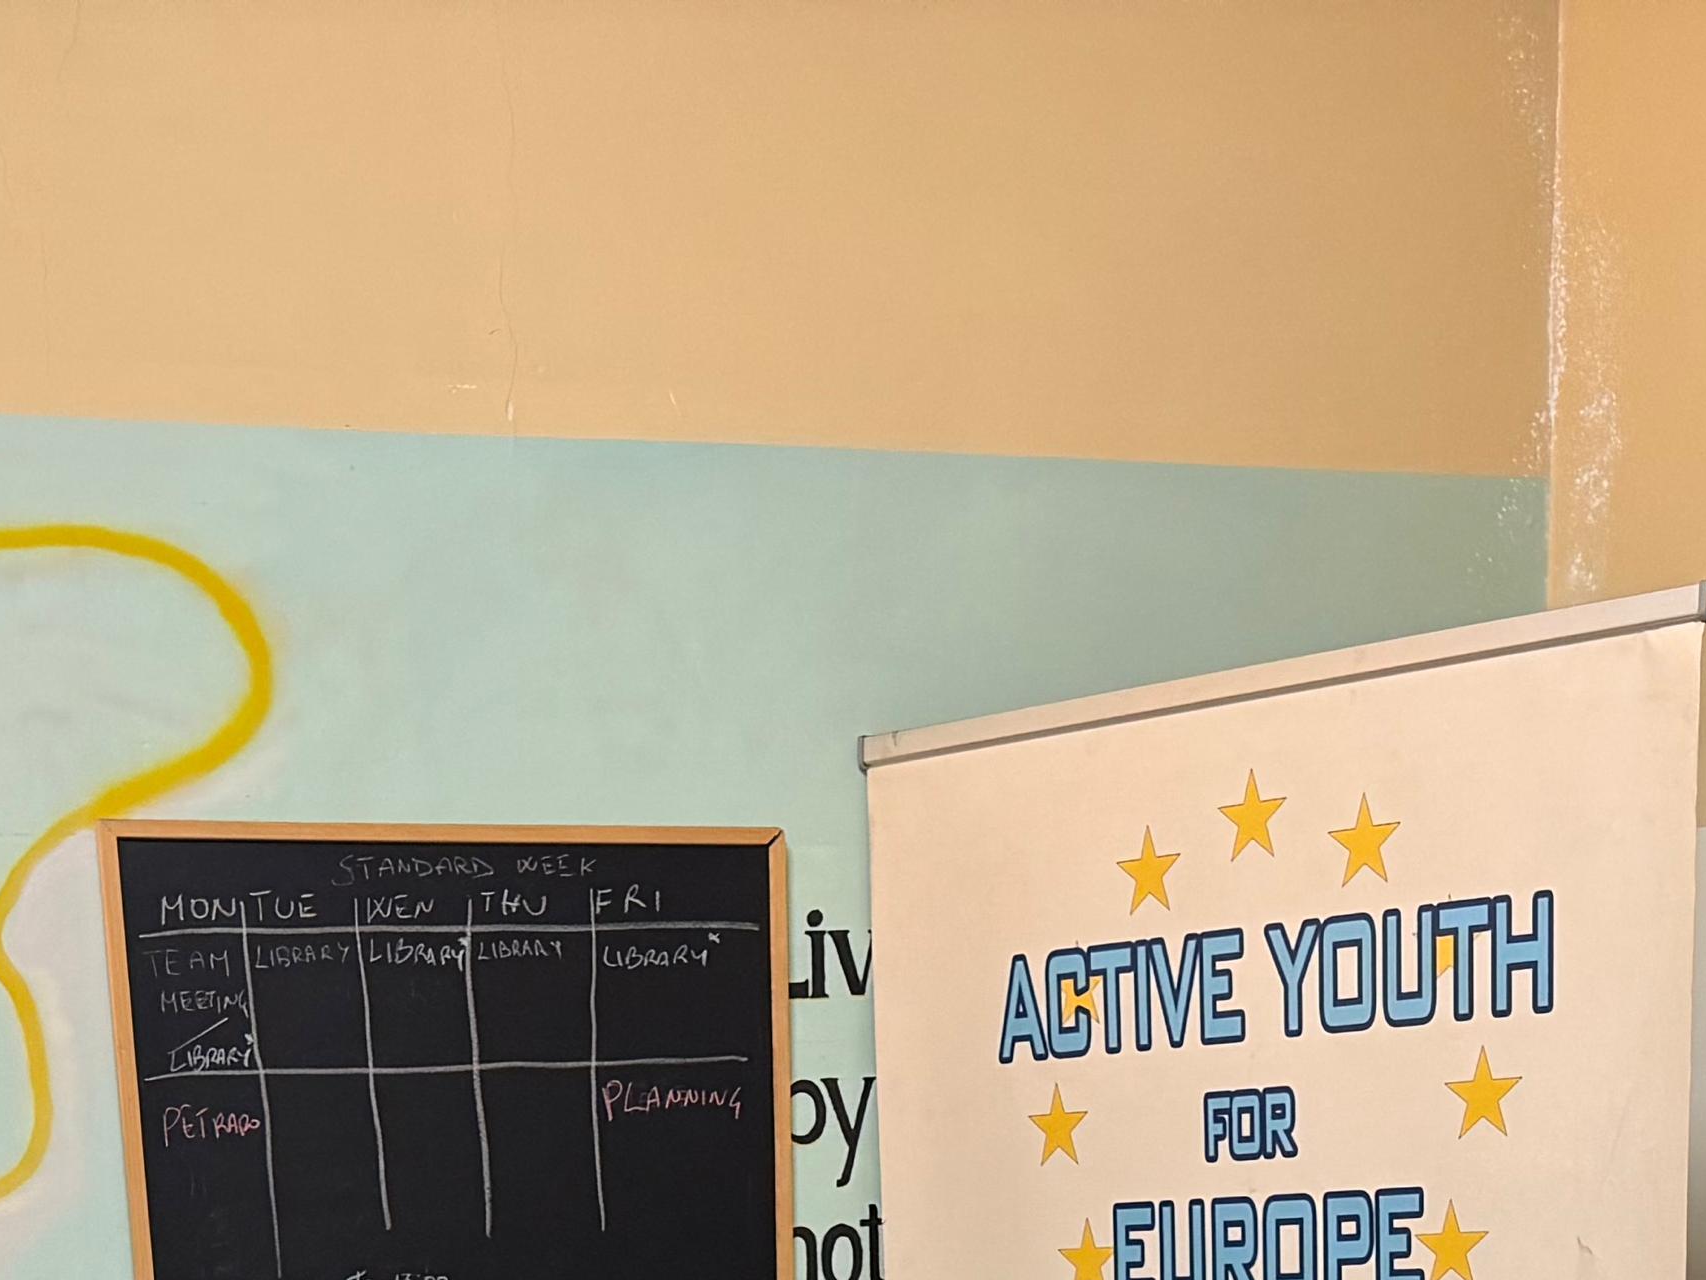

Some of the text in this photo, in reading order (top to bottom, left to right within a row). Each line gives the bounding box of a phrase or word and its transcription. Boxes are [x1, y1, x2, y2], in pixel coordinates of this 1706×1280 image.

[330, 852, 599, 888] STANDARD WEEK
[159, 895, 239, 926] MON
[250, 891, 318, 921] TUE
[479, 891, 548, 918] THU
[595, 888, 663, 917] FRI
[148, 949, 232, 978] TEAM
[254, 943, 351, 972] LIBRARY
[476, 939, 565, 962] LIBRARY
[998, 889, 1555, 1065] ACTIVE YOUTH
[600, 1078, 744, 1123] PLANNING
[1202, 1085, 1299, 1163] FOR
